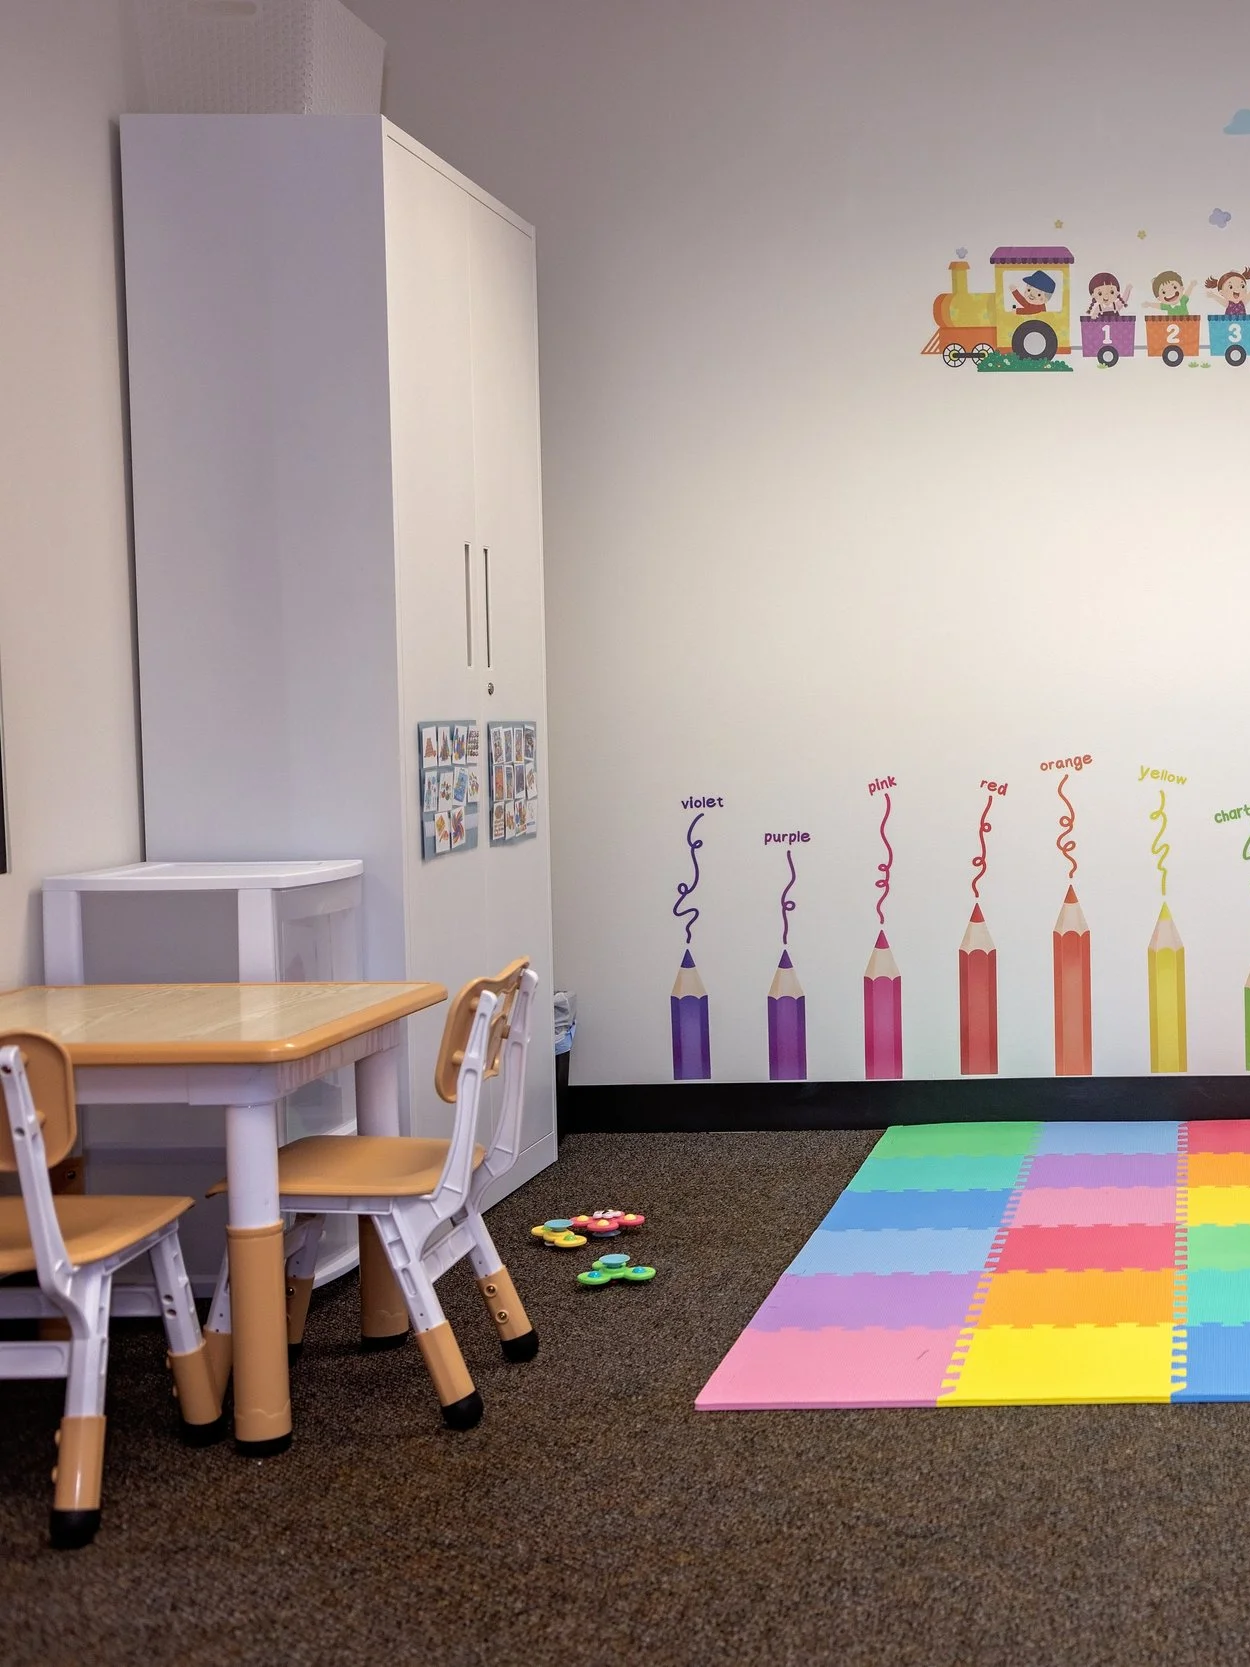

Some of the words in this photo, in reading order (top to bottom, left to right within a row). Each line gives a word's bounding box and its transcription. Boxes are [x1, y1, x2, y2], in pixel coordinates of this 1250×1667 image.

[1101, 324, 1113, 345] 1
[1166, 323, 1181, 344] 2
[1227, 323, 1243, 344] 3
[1040, 754, 1092, 771] orange
[868, 775, 897, 795] pink
[1138, 766, 1187, 785] yellow
[980, 778, 1008, 796] red
[681, 796, 724, 809] violet
[764, 831, 811, 845] purple
